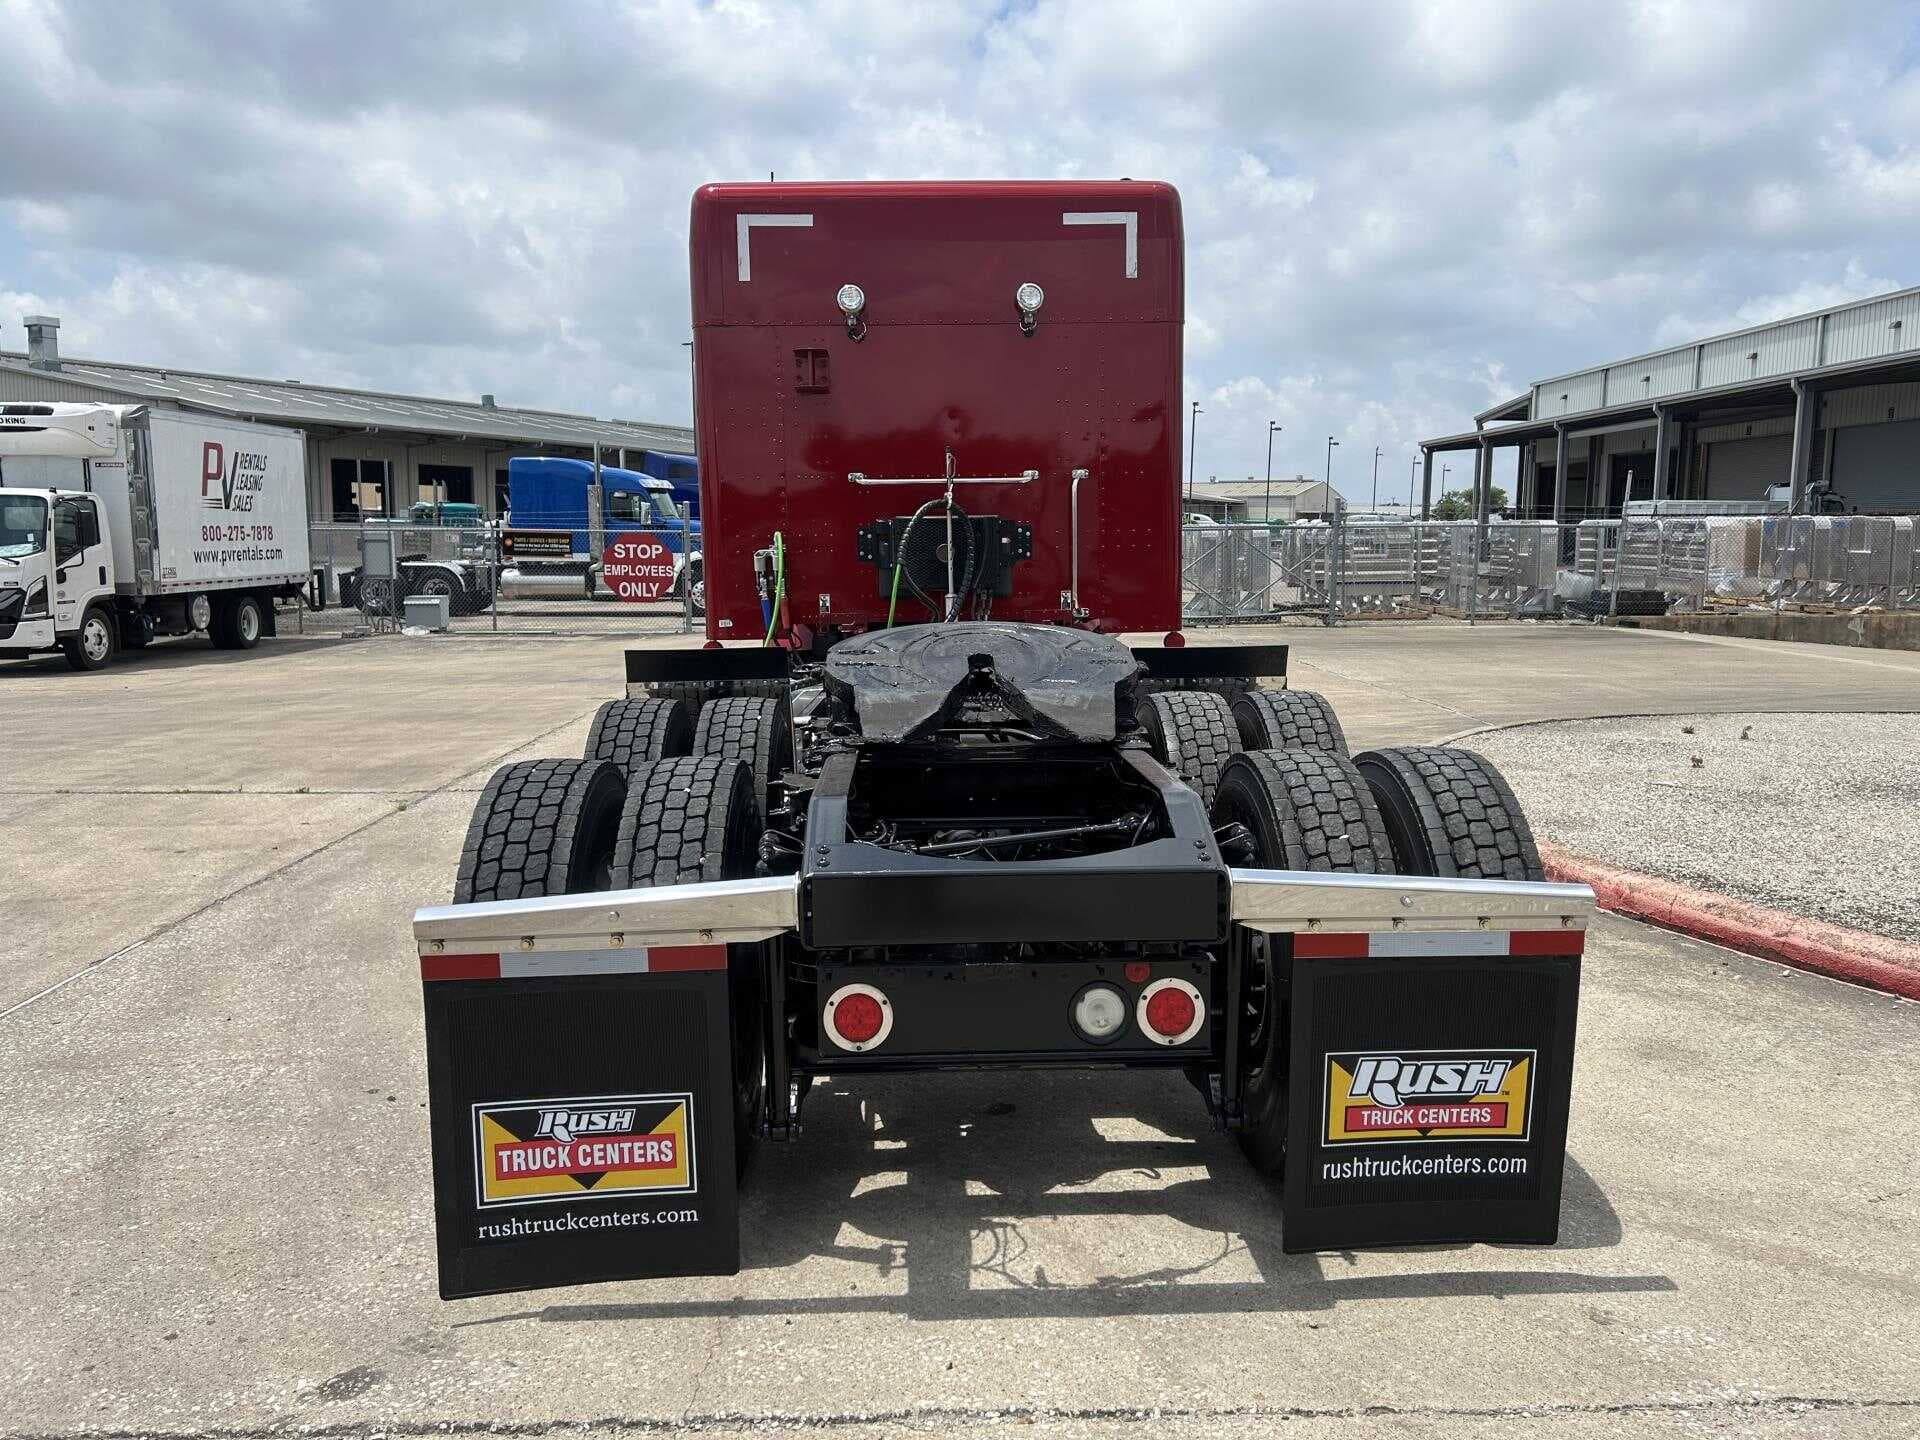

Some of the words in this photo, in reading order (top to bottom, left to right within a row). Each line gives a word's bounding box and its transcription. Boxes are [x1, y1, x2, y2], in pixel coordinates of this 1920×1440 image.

[5, 417, 26, 425] KING
[239, 453, 267, 472] RENTALS
[236, 474, 263, 492] LEASING
[232, 494, 253, 512] SALES
[202, 525, 274, 542] 800-275-7878
[194, 546, 283, 567] www.pvrentals.com
[614, 543, 663, 559] STOP
[604, 564, 674, 577] EMPLOYEES
[619, 581, 660, 597] ONLY
[1362, 1109, 1414, 1126] TRUCK
[1419, 1107, 1492, 1125] CENTERS
[498, 1143, 571, 1173] TRUCK
[577, 1140, 674, 1168] CENTERS
[1322, 1154, 1528, 1180] rushtruckcenters.com
[478, 1207, 699, 1239] rushtruckcenters.com
